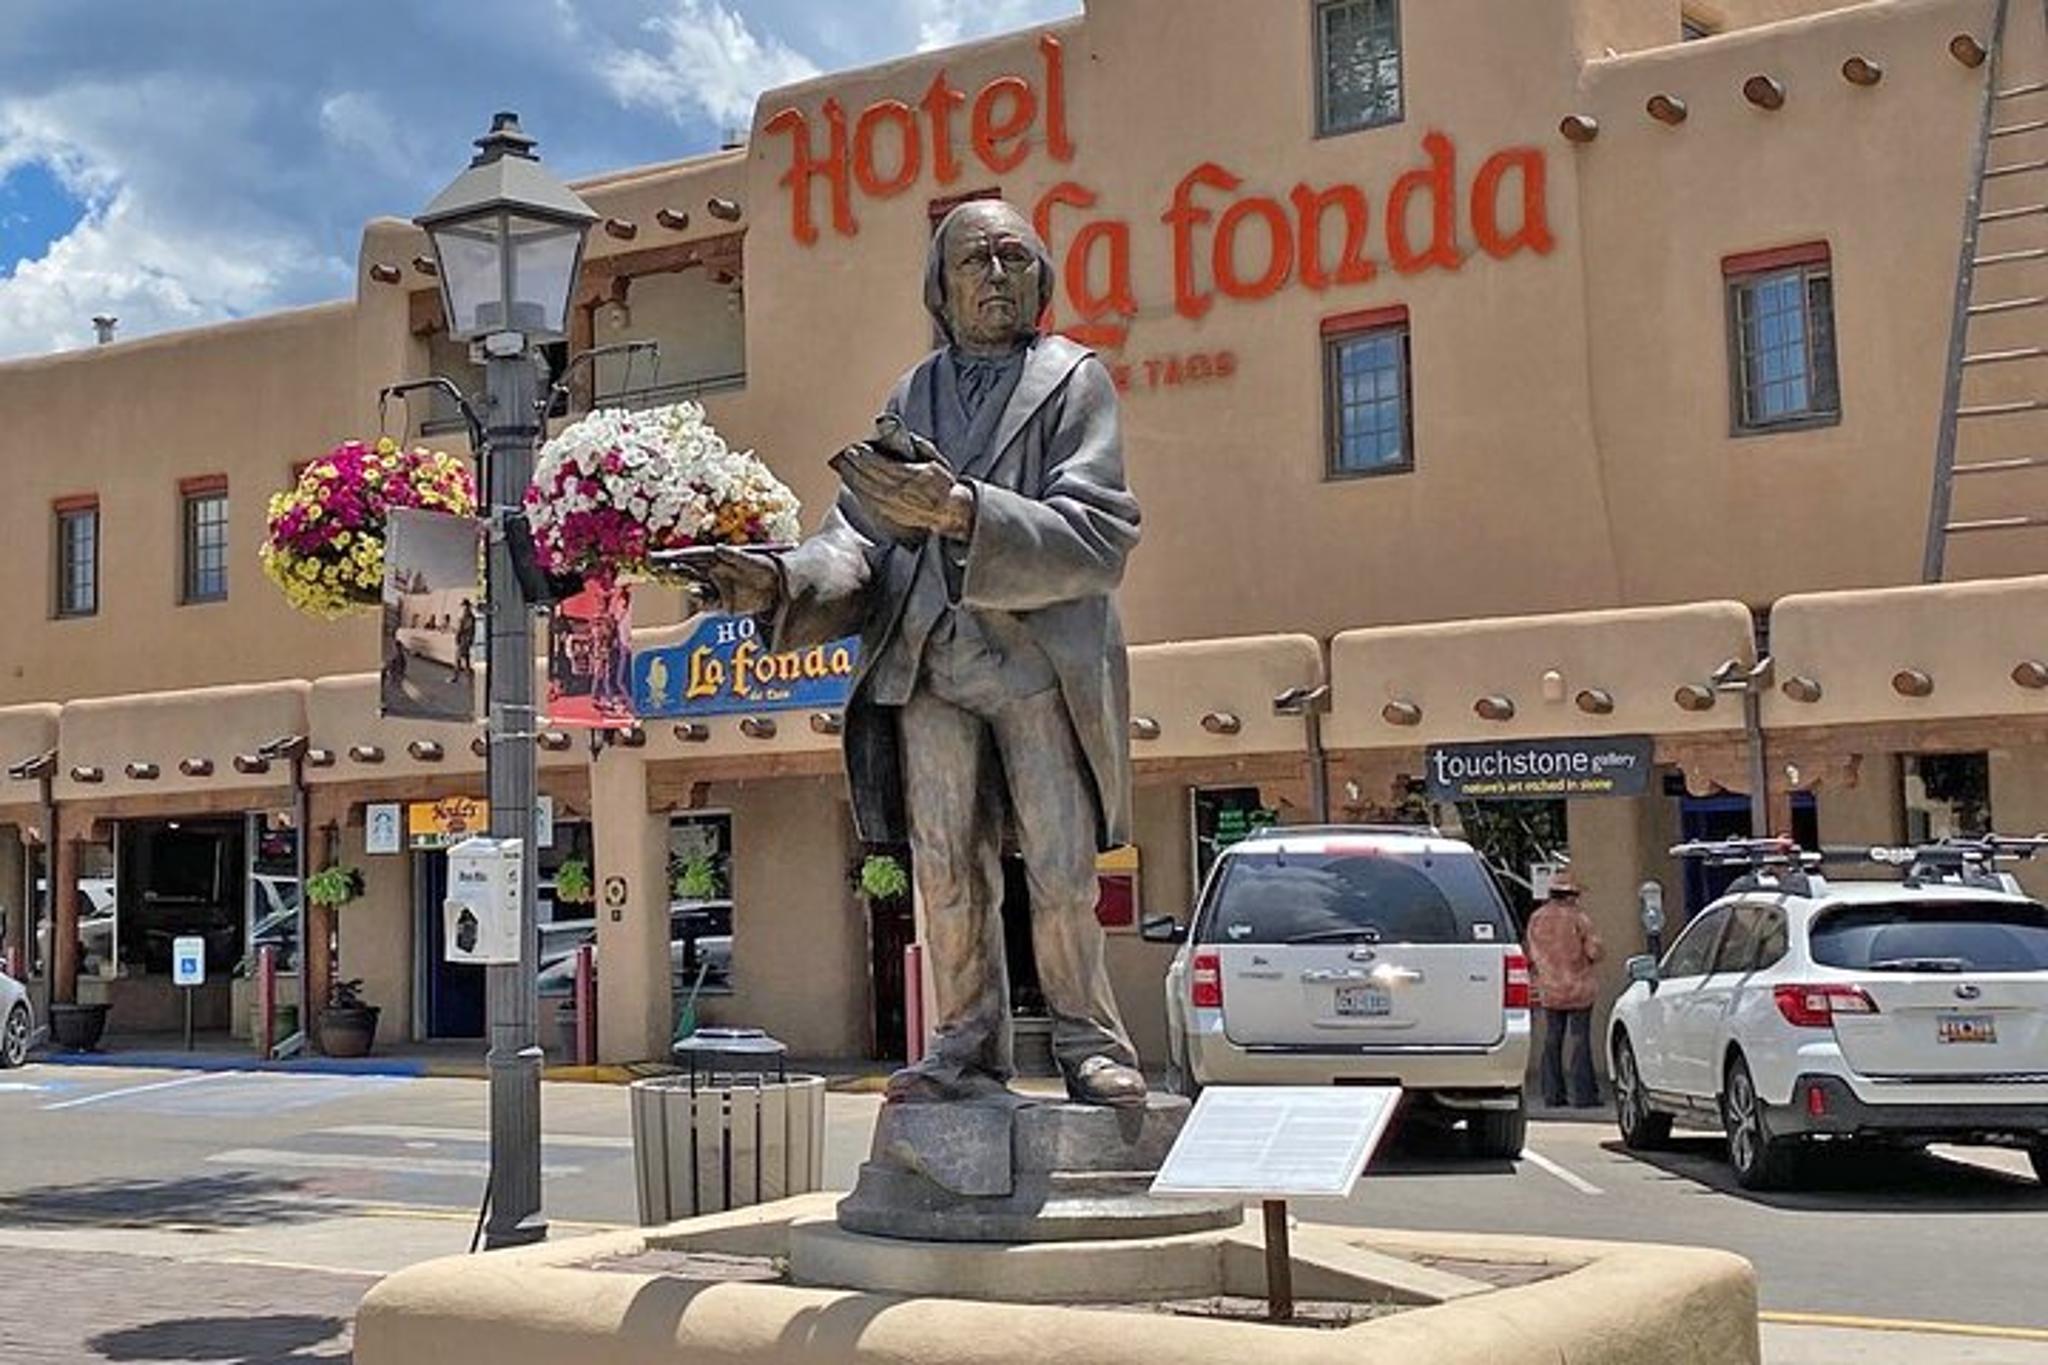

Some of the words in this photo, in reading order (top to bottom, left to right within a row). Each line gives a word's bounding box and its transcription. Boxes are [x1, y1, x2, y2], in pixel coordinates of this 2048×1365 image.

[764, 33, 1074, 248] Hotel
[1162, 125, 1557, 320] fonda
[1143, 350, 1236, 389] TAOS
[686, 645, 726, 699] La
[731, 639, 851, 698] fonda
[1433, 749, 1589, 786] touchstone
[1591, 753, 1637, 773] gallery
